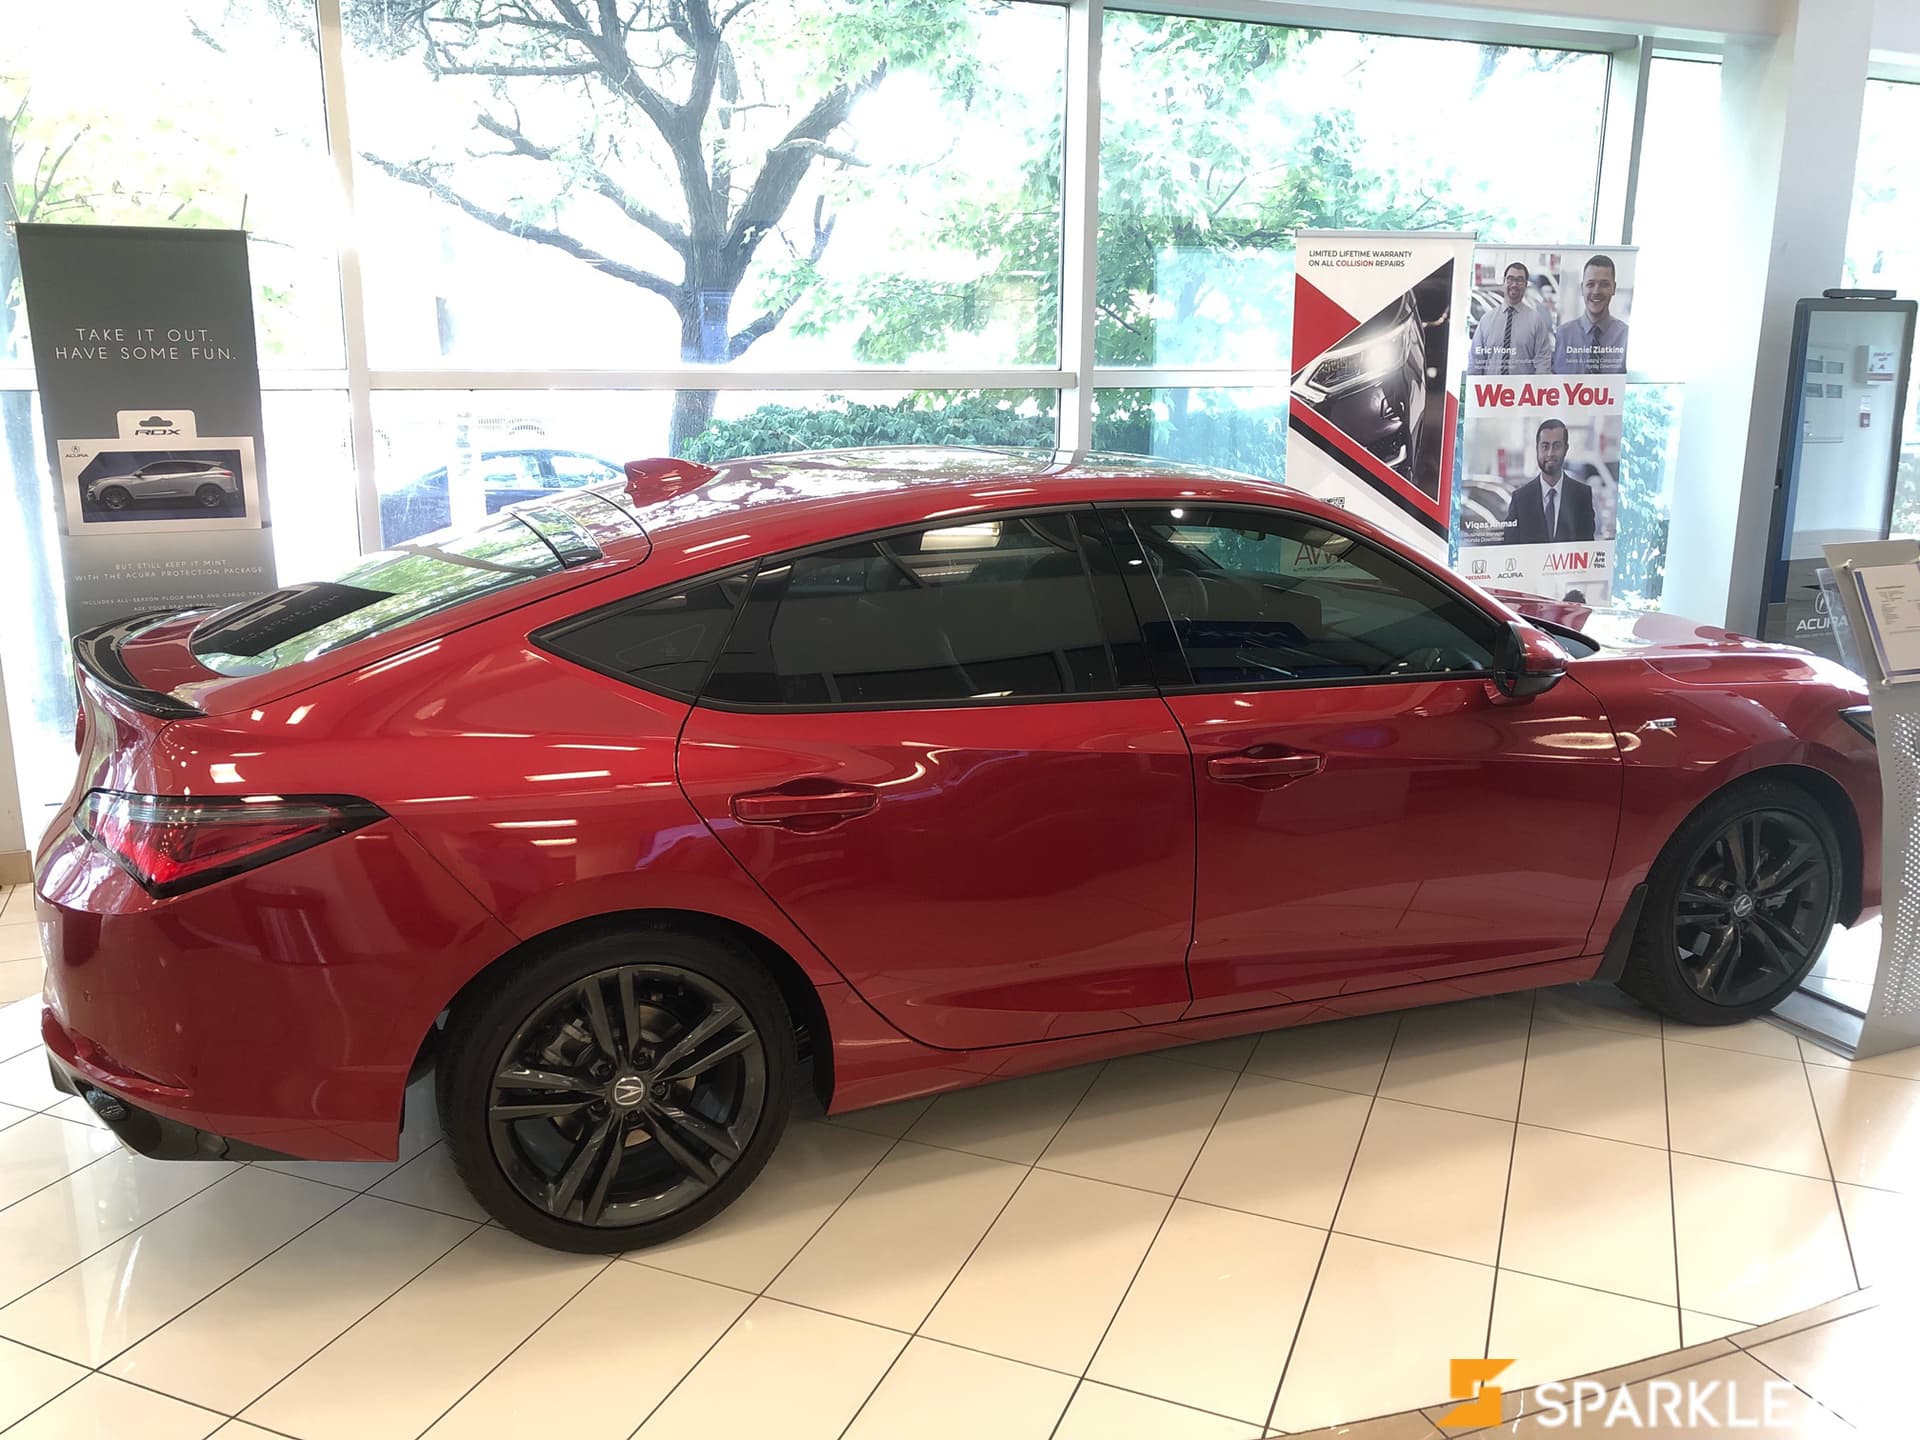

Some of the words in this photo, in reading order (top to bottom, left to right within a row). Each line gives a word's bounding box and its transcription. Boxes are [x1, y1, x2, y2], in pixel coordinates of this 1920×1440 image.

[1309, 250, 1338, 258] LIMITED
[1339, 250, 1371, 258] LIFETIME
[1372, 250, 1413, 258] WARRANTY
[75, 328, 124, 342] TAKE
[137, 328, 154, 342] IT
[167, 329, 213, 342] OUT.
[55, 347, 108, 360] HAVE
[121, 347, 178, 360] SOME
[191, 348, 236, 360] FUN.
[1475, 346, 1492, 354] Eric
[1566, 345, 1592, 354] Daniel
[1475, 384, 1515, 407] We
[1518, 384, 1560, 407] Are
[1563, 383, 1615, 406] You.
[134, 428, 182, 436] RDX
[1464, 520, 1489, 530] Viqas
[1543, 551, 1589, 571] AWIN
[75, 574, 99, 582] WITH
[126, 571, 156, 579] ACURA
[160, 568, 220, 577] PROTECTION
[224, 566, 264, 574] PACKAGE
[1497, 571, 1524, 579] ACURA
[1796, 616, 1849, 631] ACURA
